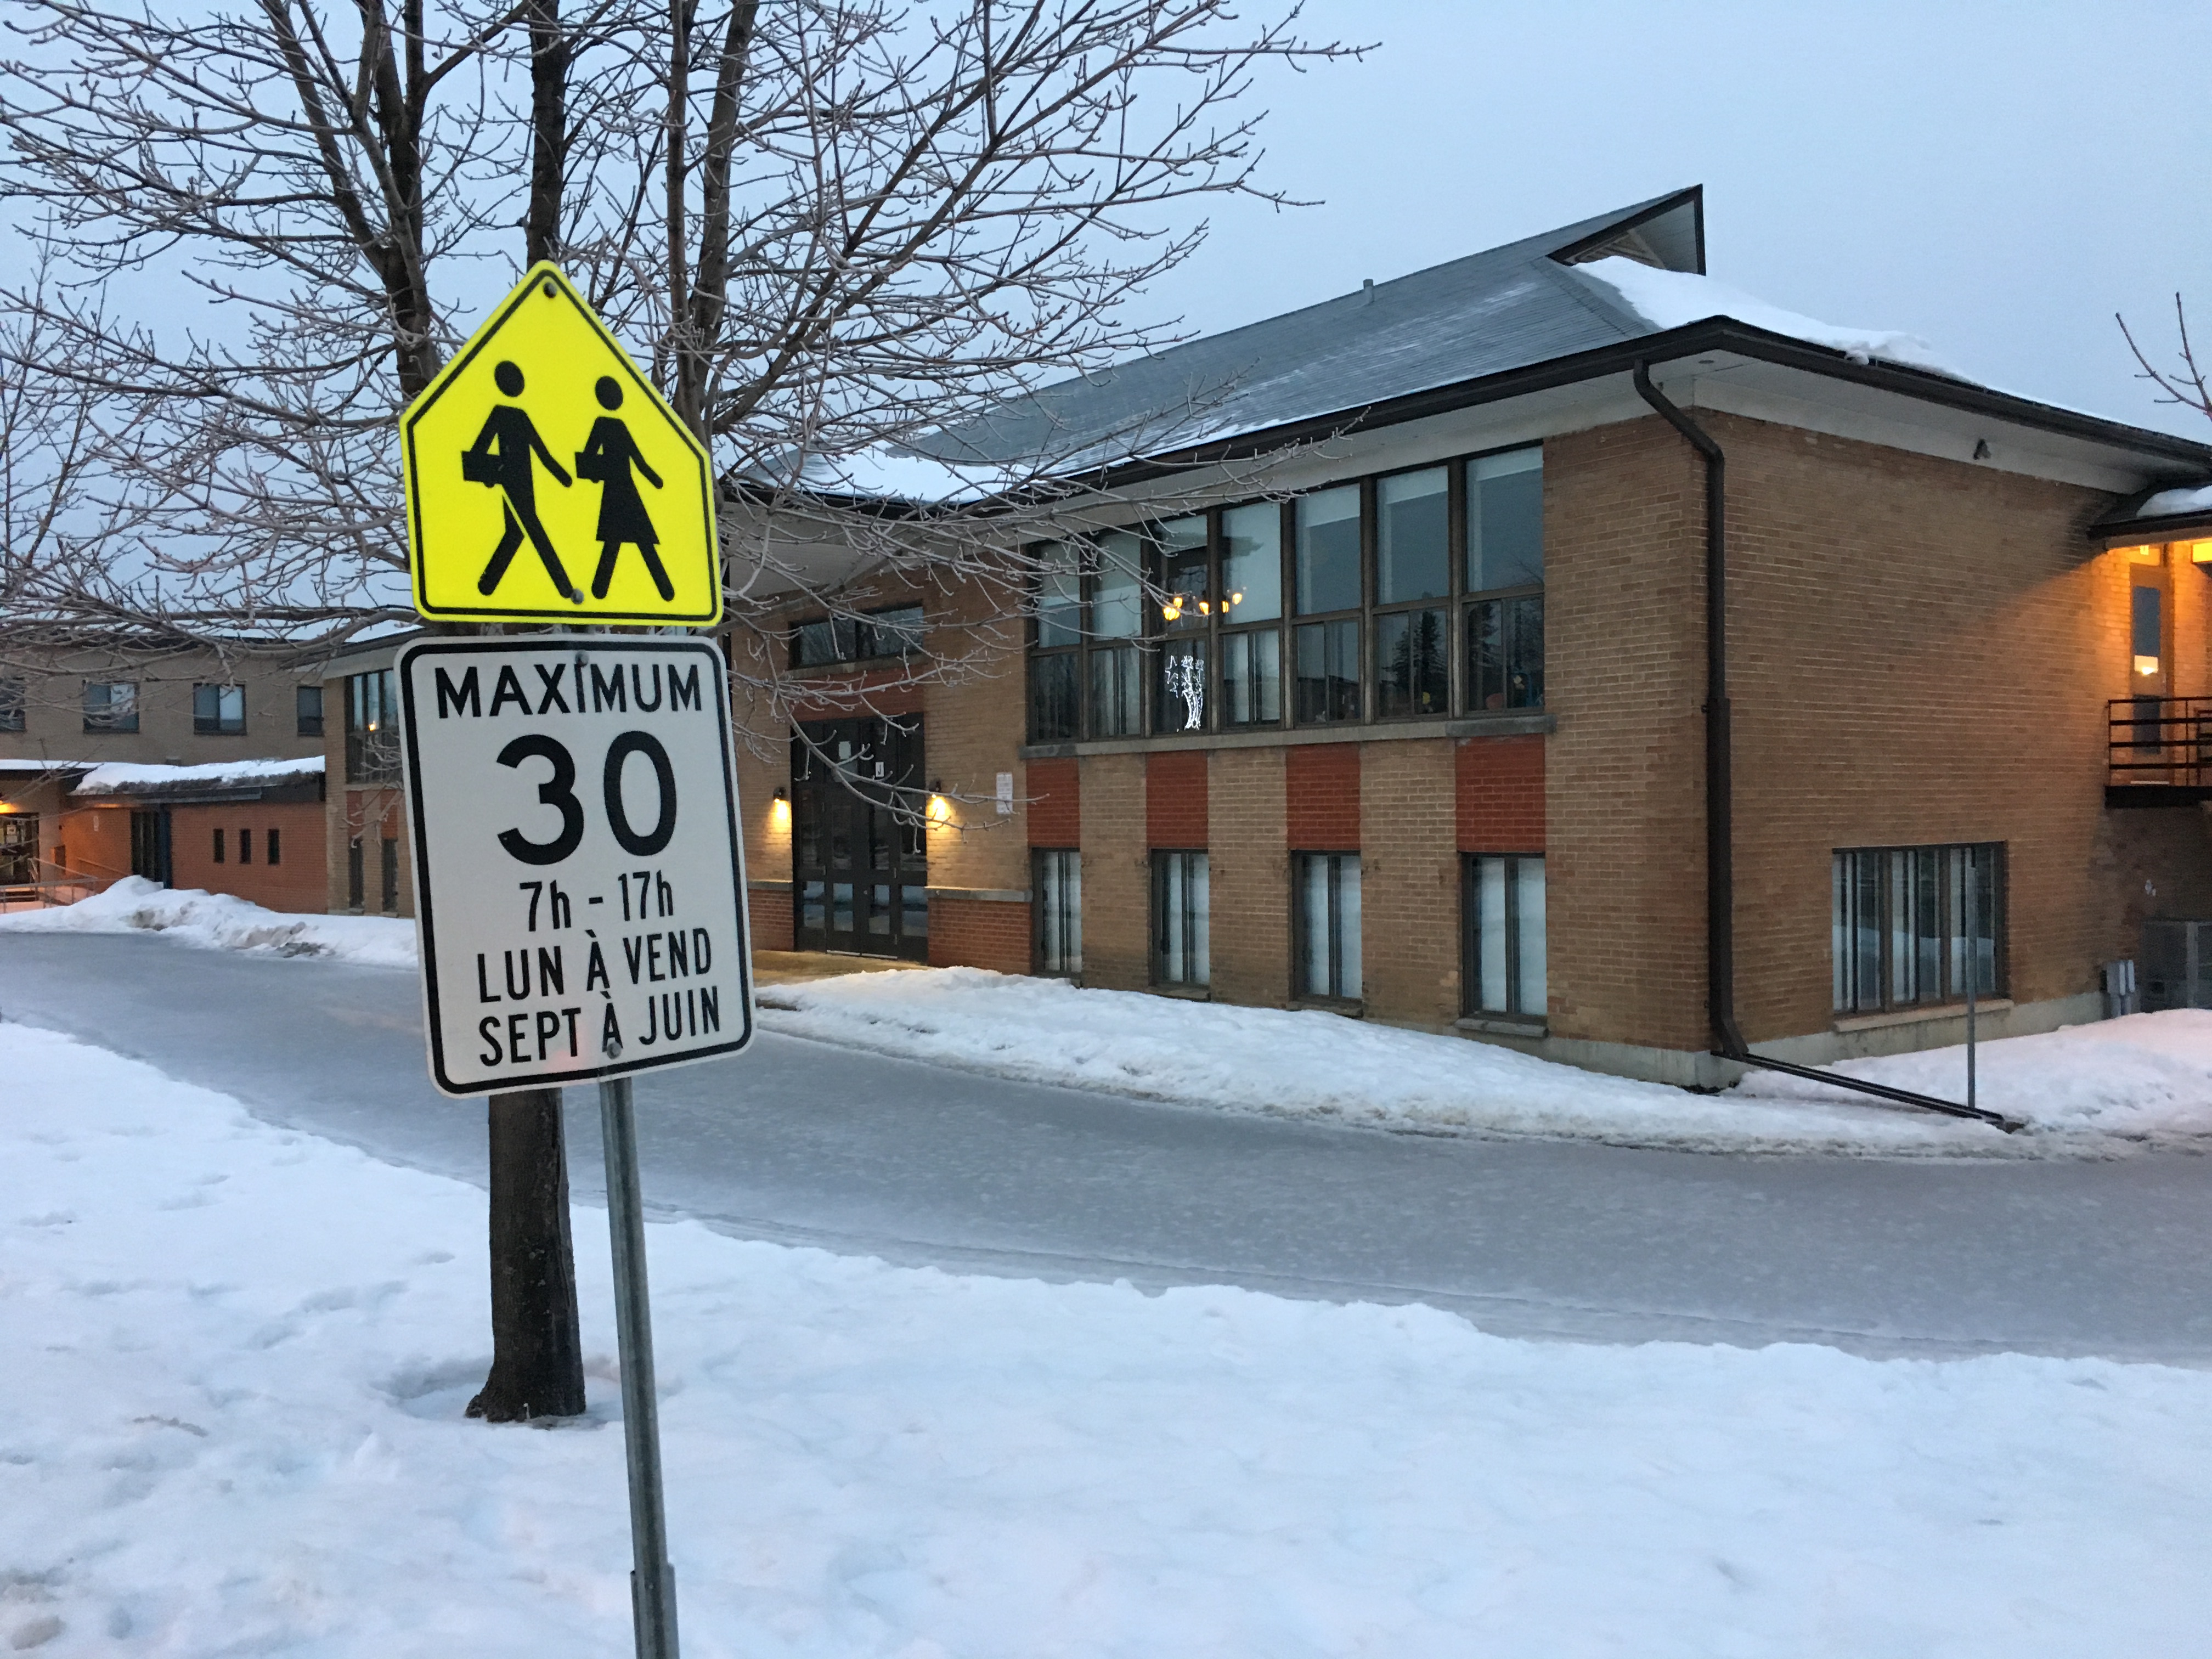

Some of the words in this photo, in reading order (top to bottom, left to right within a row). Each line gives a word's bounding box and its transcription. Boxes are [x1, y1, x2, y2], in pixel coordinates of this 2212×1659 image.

[435, 663, 702, 719] MAXIMUM
[496, 731, 678, 866] 30
[519, 880, 572, 932] 7h
[618, 870, 674, 922] 17h
[477, 945, 565, 1004] LUN
[585, 929, 611, 992] À
[623, 927, 712, 985] VEND
[479, 1007, 582, 1067] SEPT
[600, 990, 623, 1060] À
[639, 985, 720, 1046] JUIN
